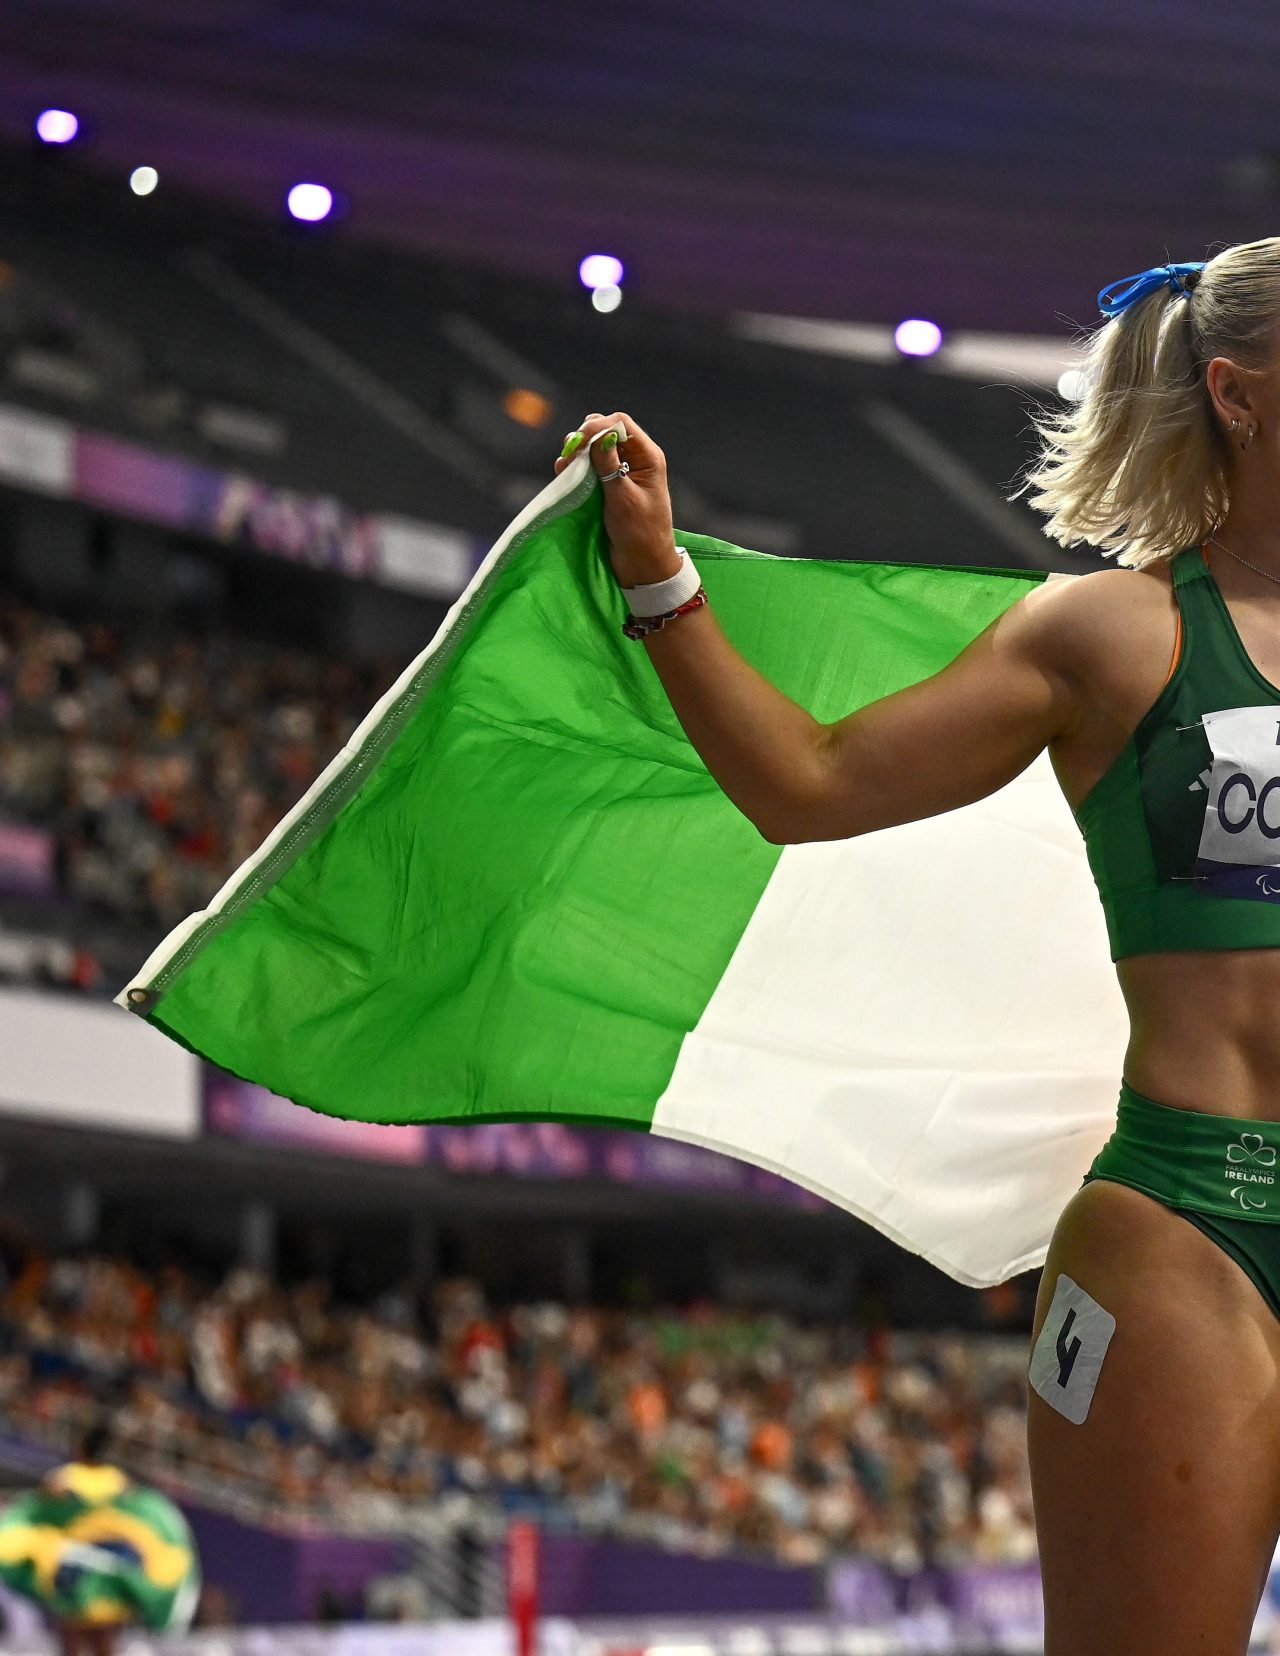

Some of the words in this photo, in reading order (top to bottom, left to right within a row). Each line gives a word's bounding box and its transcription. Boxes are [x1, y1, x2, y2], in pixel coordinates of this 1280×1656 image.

[1224, 1170, 1275, 1185] IRELAND
[1225, 1164, 1275, 1177] PARALYMPICS
[1056, 1307, 1082, 1389] 4
